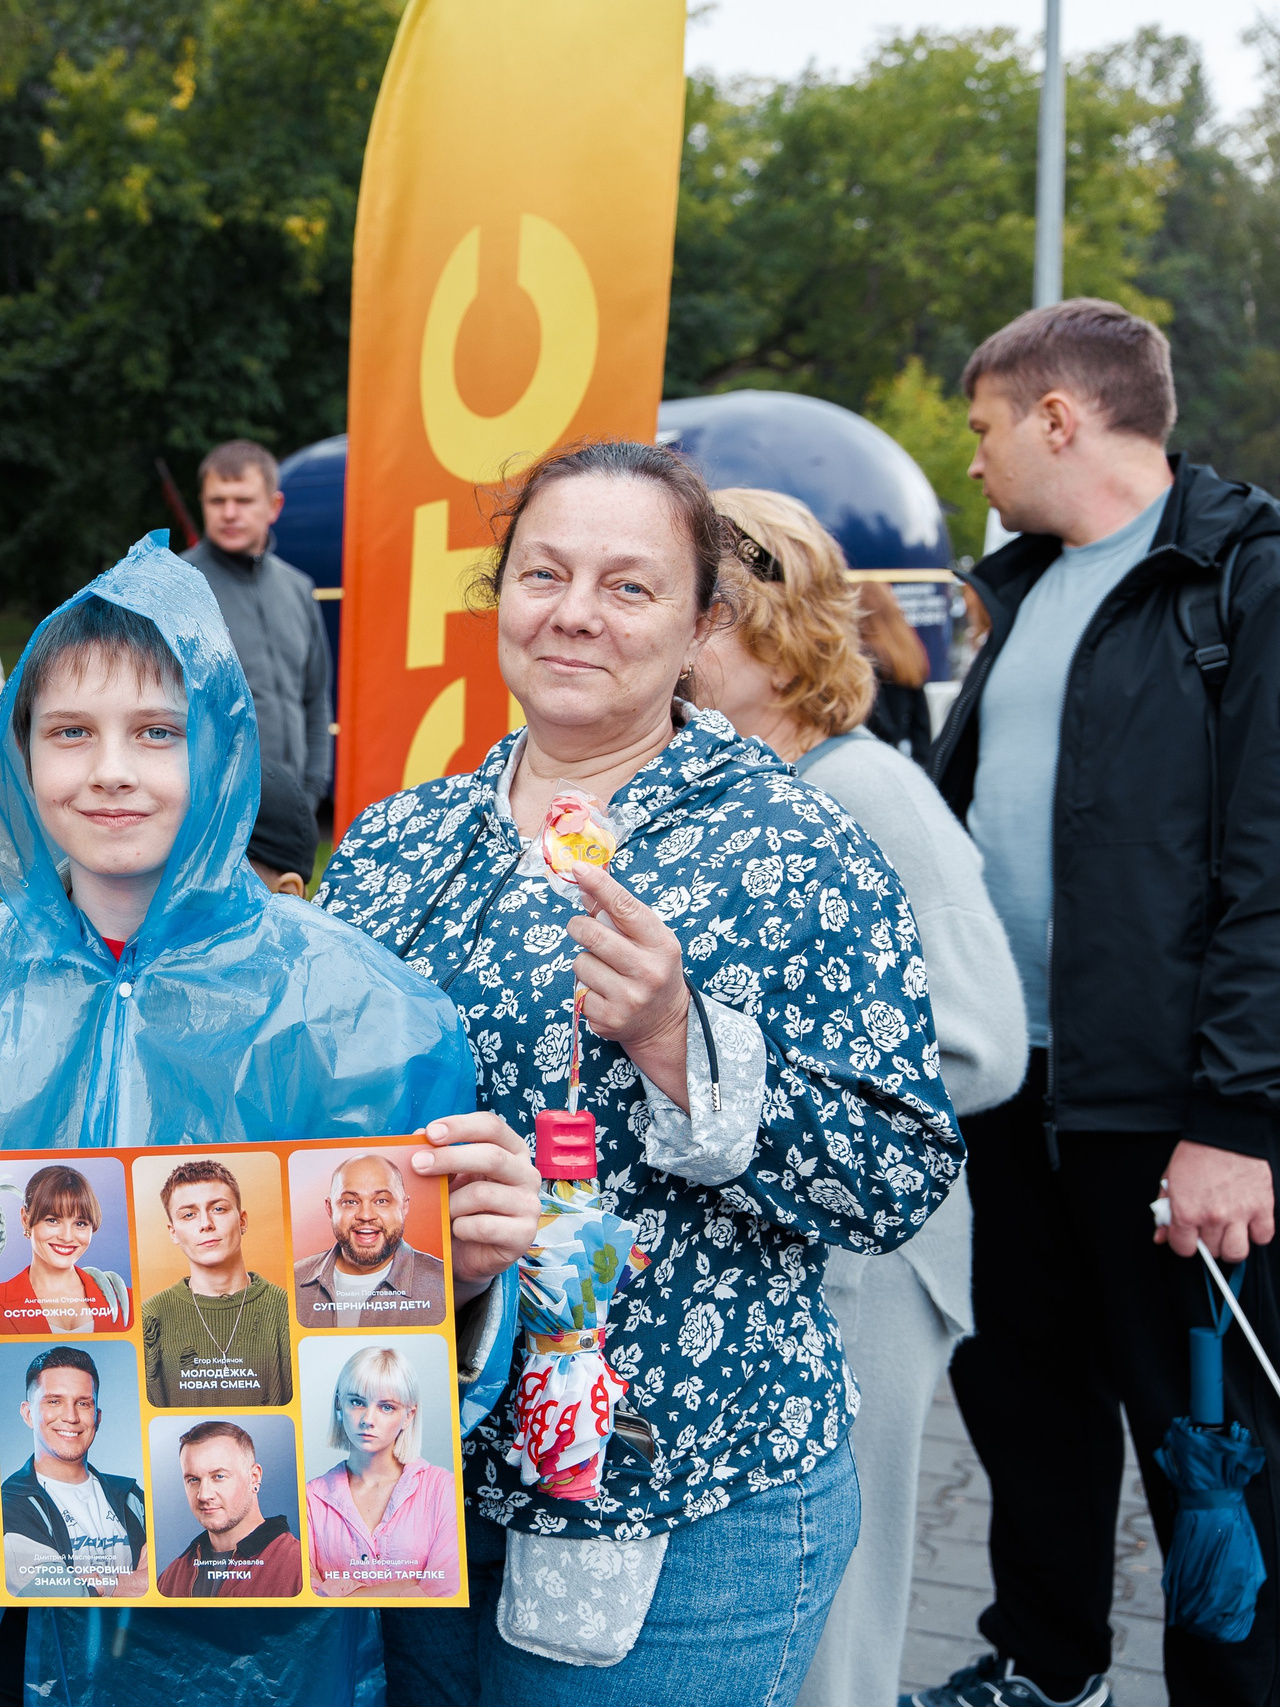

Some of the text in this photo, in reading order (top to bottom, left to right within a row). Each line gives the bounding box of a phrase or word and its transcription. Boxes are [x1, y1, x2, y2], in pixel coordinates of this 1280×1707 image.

[400, 213, 599, 791] ТС
[312, 1300, 431, 1311] СУПЕРНИНДЗЯ ДЕТИ
[3, 1307, 78, 1319] ОСТОРОЖНО,
[193, 1357, 211, 1366] Егор
[179, 1379, 261, 1390] НОВАЯ СМЕНА
[33, 1553, 66, 1561] Дмитрий
[349, 1558, 370, 1566] Даша
[192, 1558, 265, 1567] Дмитрий Журавлёв
[19, 1565, 64, 1575] ОСТРОВ
[207, 1570, 252, 1580] ПРЯТКИ
[324, 1568, 446, 1580] НЕ В СВОЕЙ ТАРЕЛКЕ
[34, 1577, 119, 1587] ЗНАКИ СУДЬБЫ
